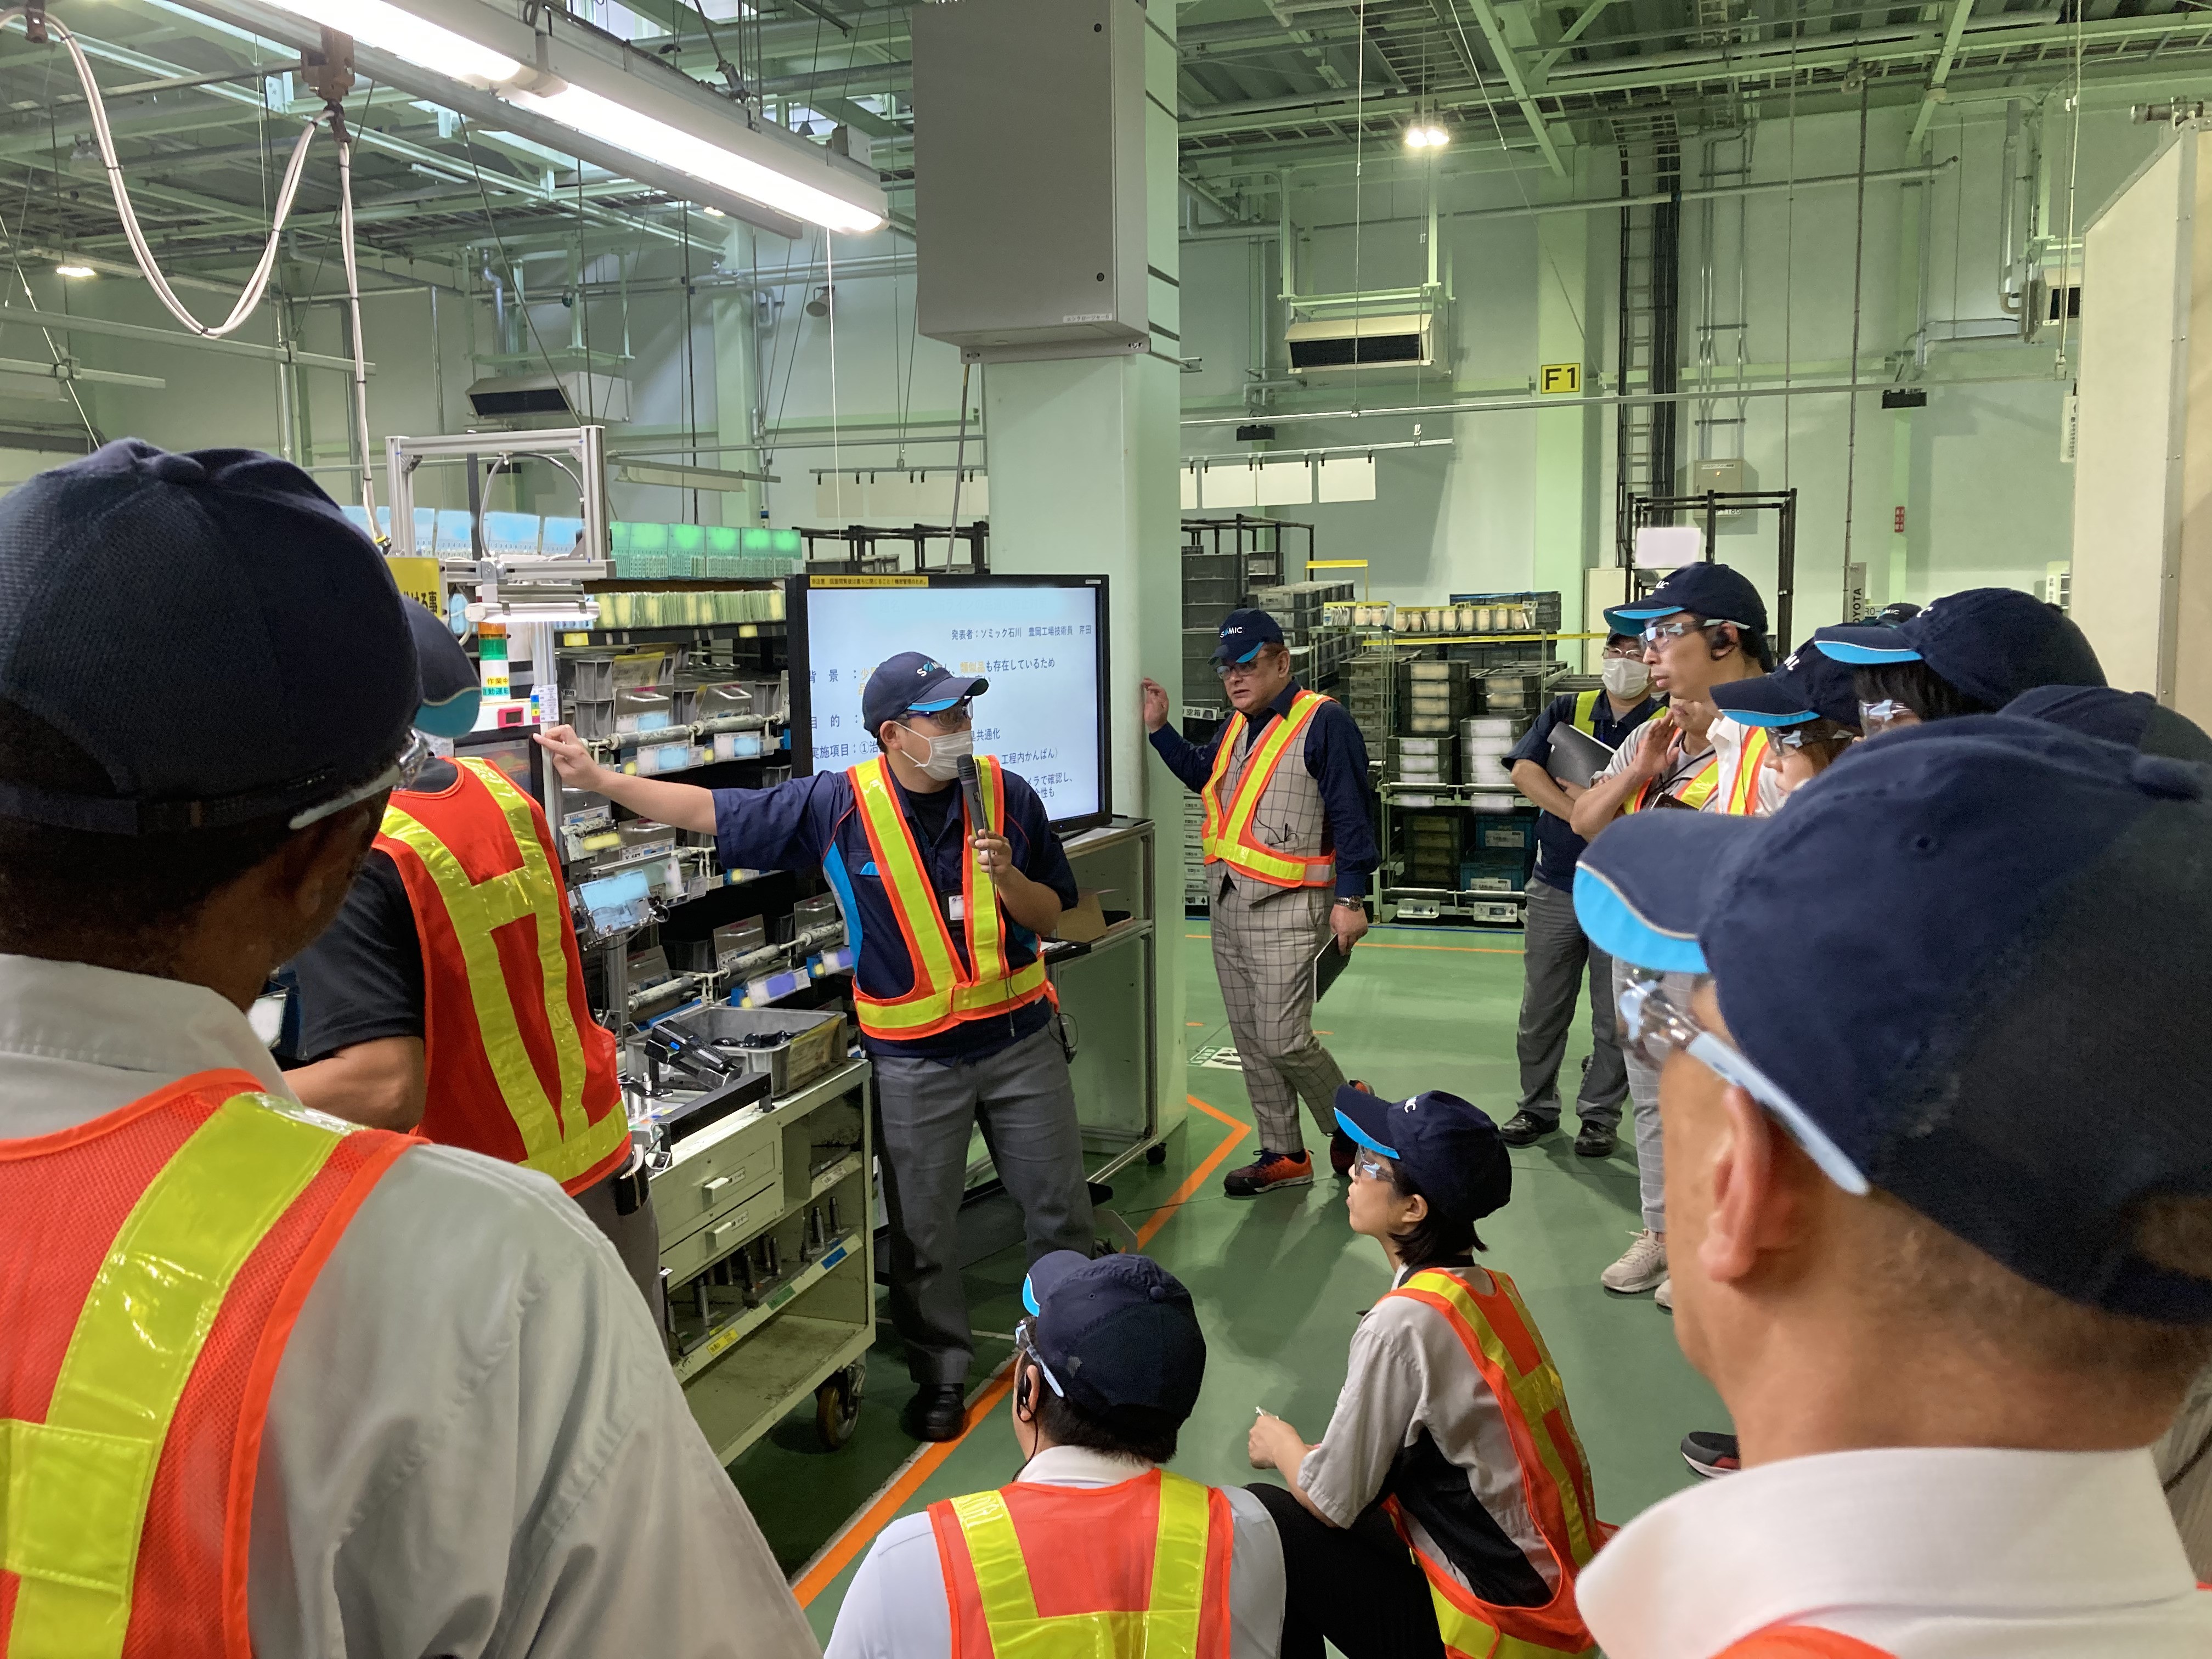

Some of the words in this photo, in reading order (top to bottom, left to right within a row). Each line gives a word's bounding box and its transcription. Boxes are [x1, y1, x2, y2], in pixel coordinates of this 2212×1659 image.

[1545, 367, 1576, 390] F1
[951, 627, 1022, 641] 発表者：ソミック石川
[1028, 625, 1073, 637] 豊岡工場技術員
[1079, 624, 1092, 635] 芹田
[487, 677, 509, 685] 作業中
[828, 669, 839, 682] 景
[830, 714, 840, 729] 的
